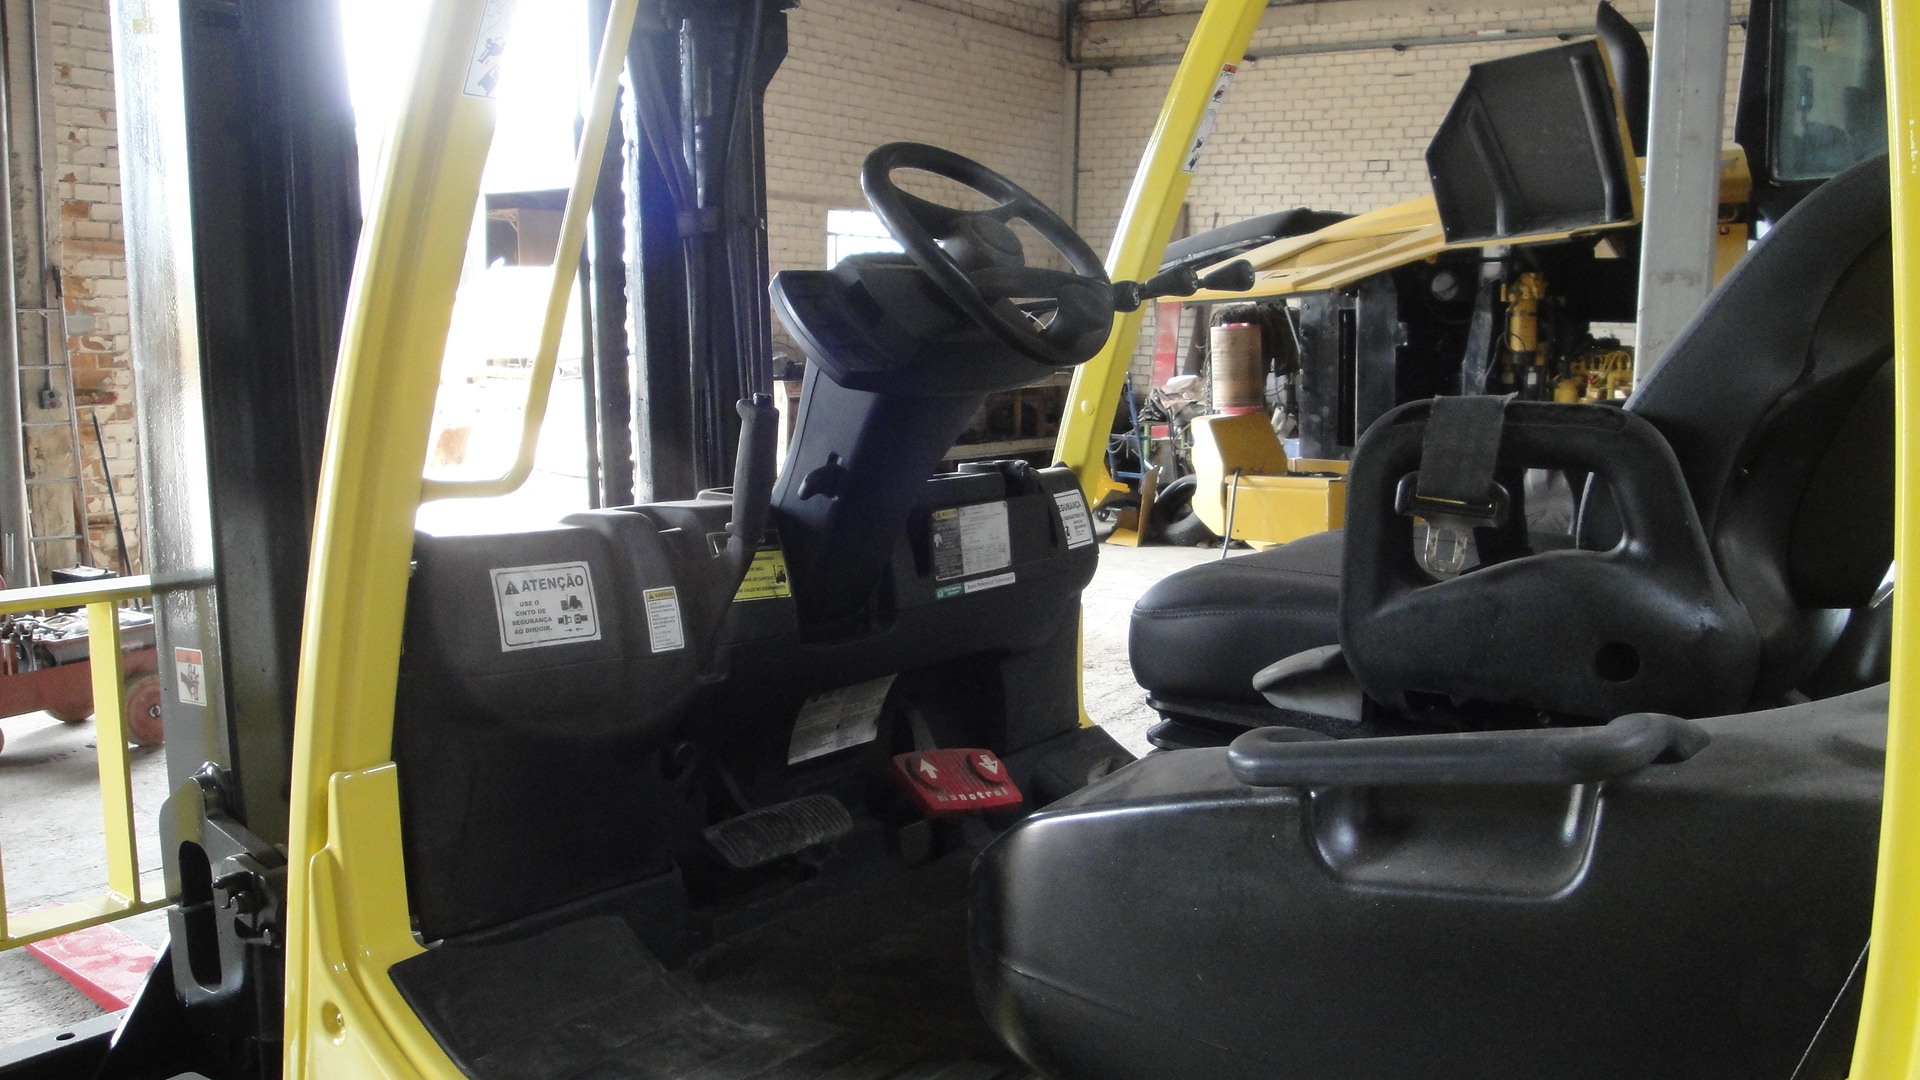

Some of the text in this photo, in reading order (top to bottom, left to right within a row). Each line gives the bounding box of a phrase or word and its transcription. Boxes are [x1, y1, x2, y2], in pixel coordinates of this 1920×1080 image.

[1057, 501, 1081, 512] EGURANÇA
[522, 573, 584, 592] ATENÇÃO
[515, 609, 536, 617] CINTO
[512, 616, 552, 626] SEGURANÇA
[937, 787, 1008, 801] monotrol
